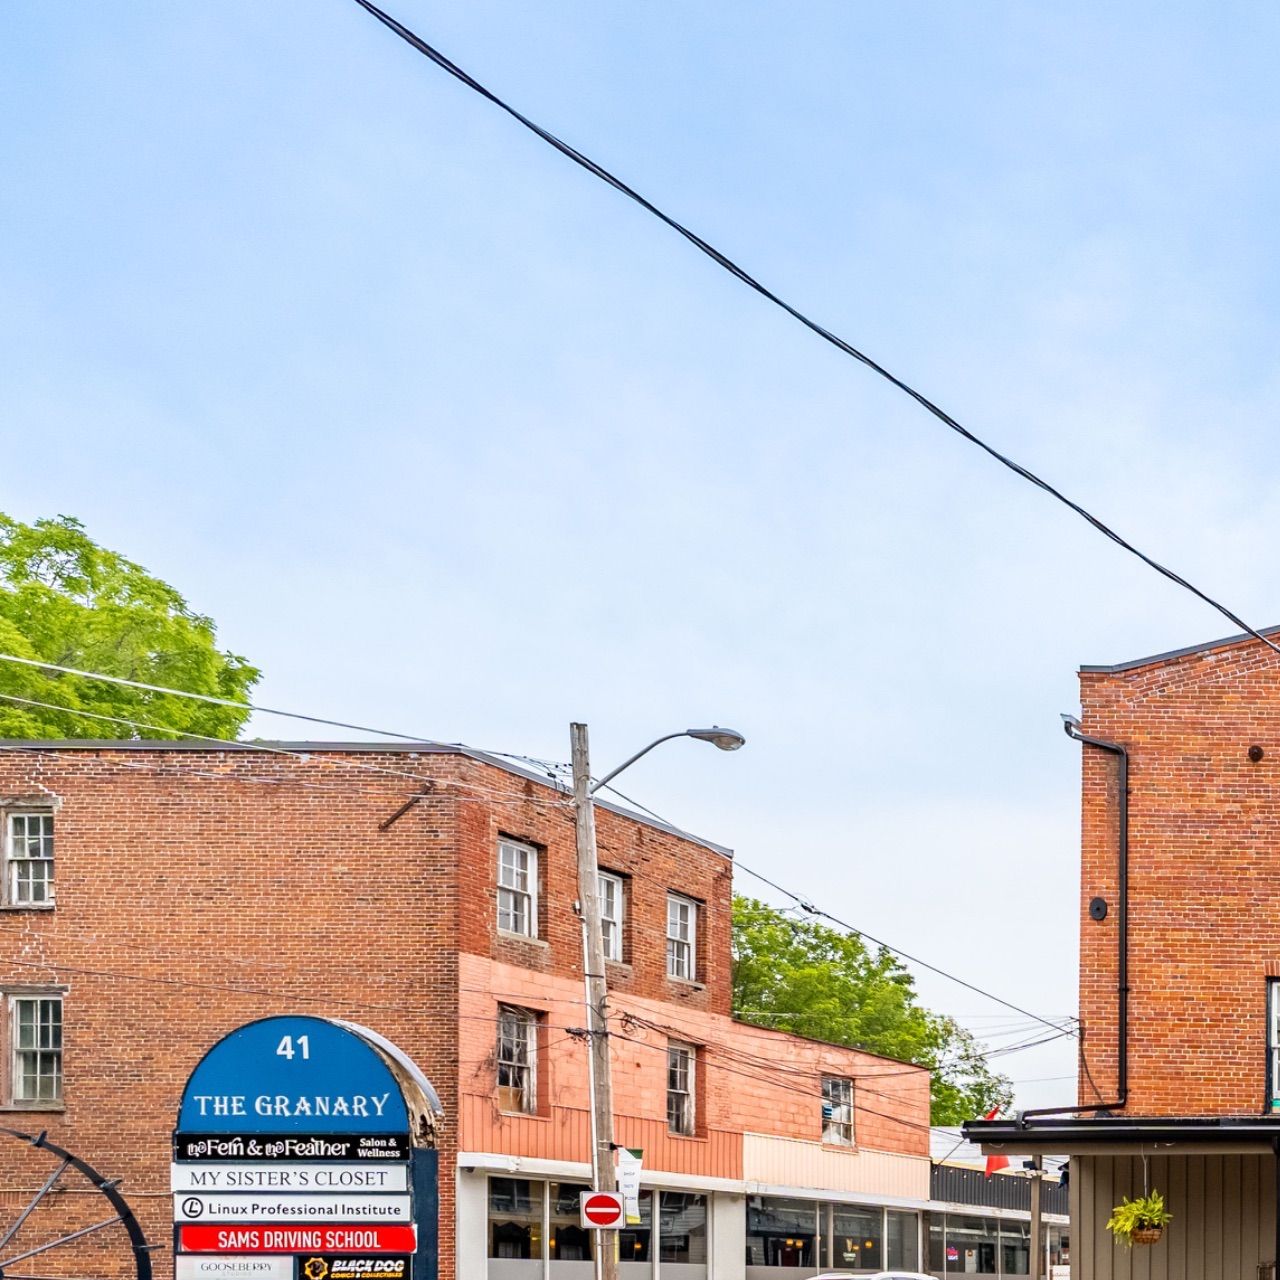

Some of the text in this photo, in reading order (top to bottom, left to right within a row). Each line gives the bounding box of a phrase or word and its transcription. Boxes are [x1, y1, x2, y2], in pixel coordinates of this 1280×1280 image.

[276, 1035, 310, 1060] 41
[194, 1092, 391, 1118] THE GRANARY
[246, 1139, 264, 1156] &
[359, 1138, 397, 1147] Salon &
[357, 1148, 401, 1158] Wellness
[190, 1171, 389, 1186] MY SISTER'S CLOSET
[208, 1203, 401, 1215] Linux Professional Institute
[218, 1231, 381, 1248] SAMS DRIVING SCHOOL
[200, 1262, 272, 1271] GOOSEBERRY
[331, 1259, 405, 1273] BLACK DOG
